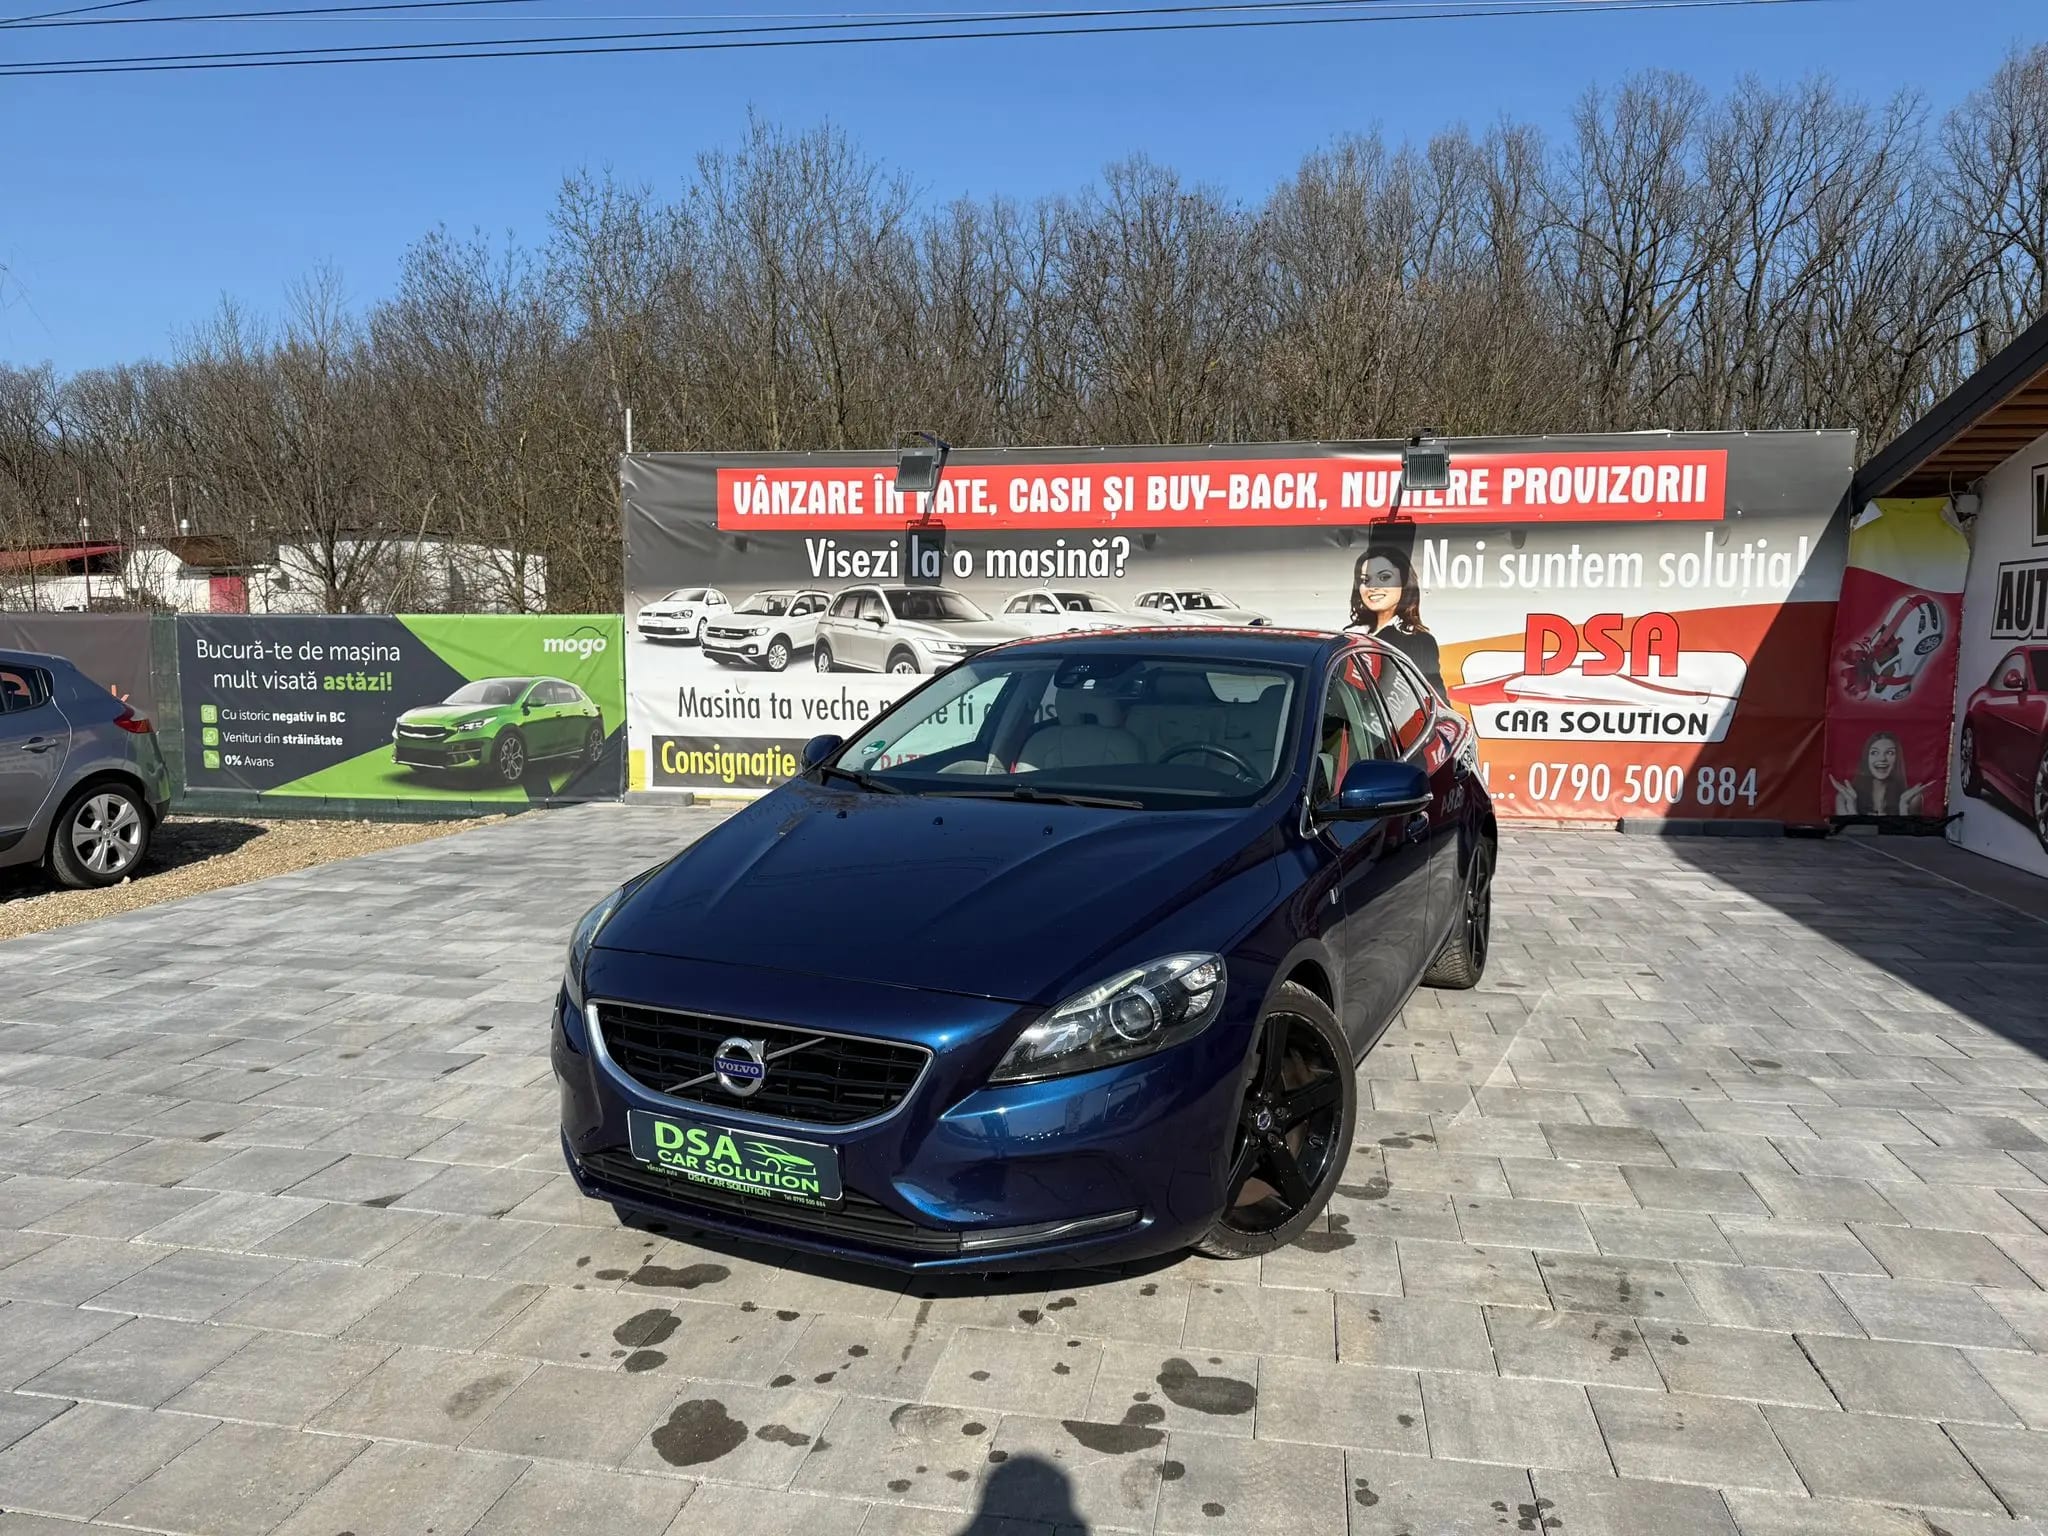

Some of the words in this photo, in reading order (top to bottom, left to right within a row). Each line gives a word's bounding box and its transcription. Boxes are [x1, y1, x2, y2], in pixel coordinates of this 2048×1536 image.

[732, 473, 864, 515] VÂNZARE
[873, 473, 904, 514] ÎN
[1009, 476, 1091, 514] CASH
[1103, 476, 1134, 520] ȘI
[1146, 472, 1328, 511] BUY-BACK,
[1502, 465, 1708, 505] PROVIZORII
[804, 538, 899, 578] Visezi
[911, 534, 940, 578] la
[953, 551, 973, 578] o
[1422, 539, 1486, 589] Noi
[1499, 544, 1643, 589] suntem
[1659, 531, 1808, 598] soluția!
[197, 639, 293, 661] Bucură-te
[299, 641, 323, 661] de
[329, 642, 400, 666] mașina
[543, 638, 607, 660] mogo
[1523, 612, 1680, 677] DSA
[213, 670, 258, 689] mult
[262, 671, 318, 690] visată
[323, 671, 393, 691] astăzi!
[221, 709, 237, 720] Cu
[239, 709, 271, 721] istoric
[273, 711, 314, 724] negativ
[330, 712, 346, 723] BC
[769, 692, 792, 720] ta
[801, 686, 869, 721] veche
[1495, 710, 1549, 733] CAR
[1560, 711, 1708, 735] SOLUTION
[222, 731, 262, 744] Venituri
[264, 733, 281, 745] din
[282, 735, 343, 746] străinătate
[224, 755, 242, 766] 0%
[244, 756, 274, 767] Avans
[661, 740, 796, 784] Consignație
[1528, 761, 1611, 802] 0790
[1622, 763, 1684, 804] 500
[1696, 766, 1757, 806] 884
[716, 1060, 760, 1075] VOLVO
[654, 1121, 743, 1165] DSA
[657, 1150, 700, 1169] CAR
[704, 1159, 820, 1193] SOLUTION
[687, 1172, 706, 1184] DSA
[707, 1178, 725, 1188] CAR
[726, 1181, 771, 1198] SOLUTION
